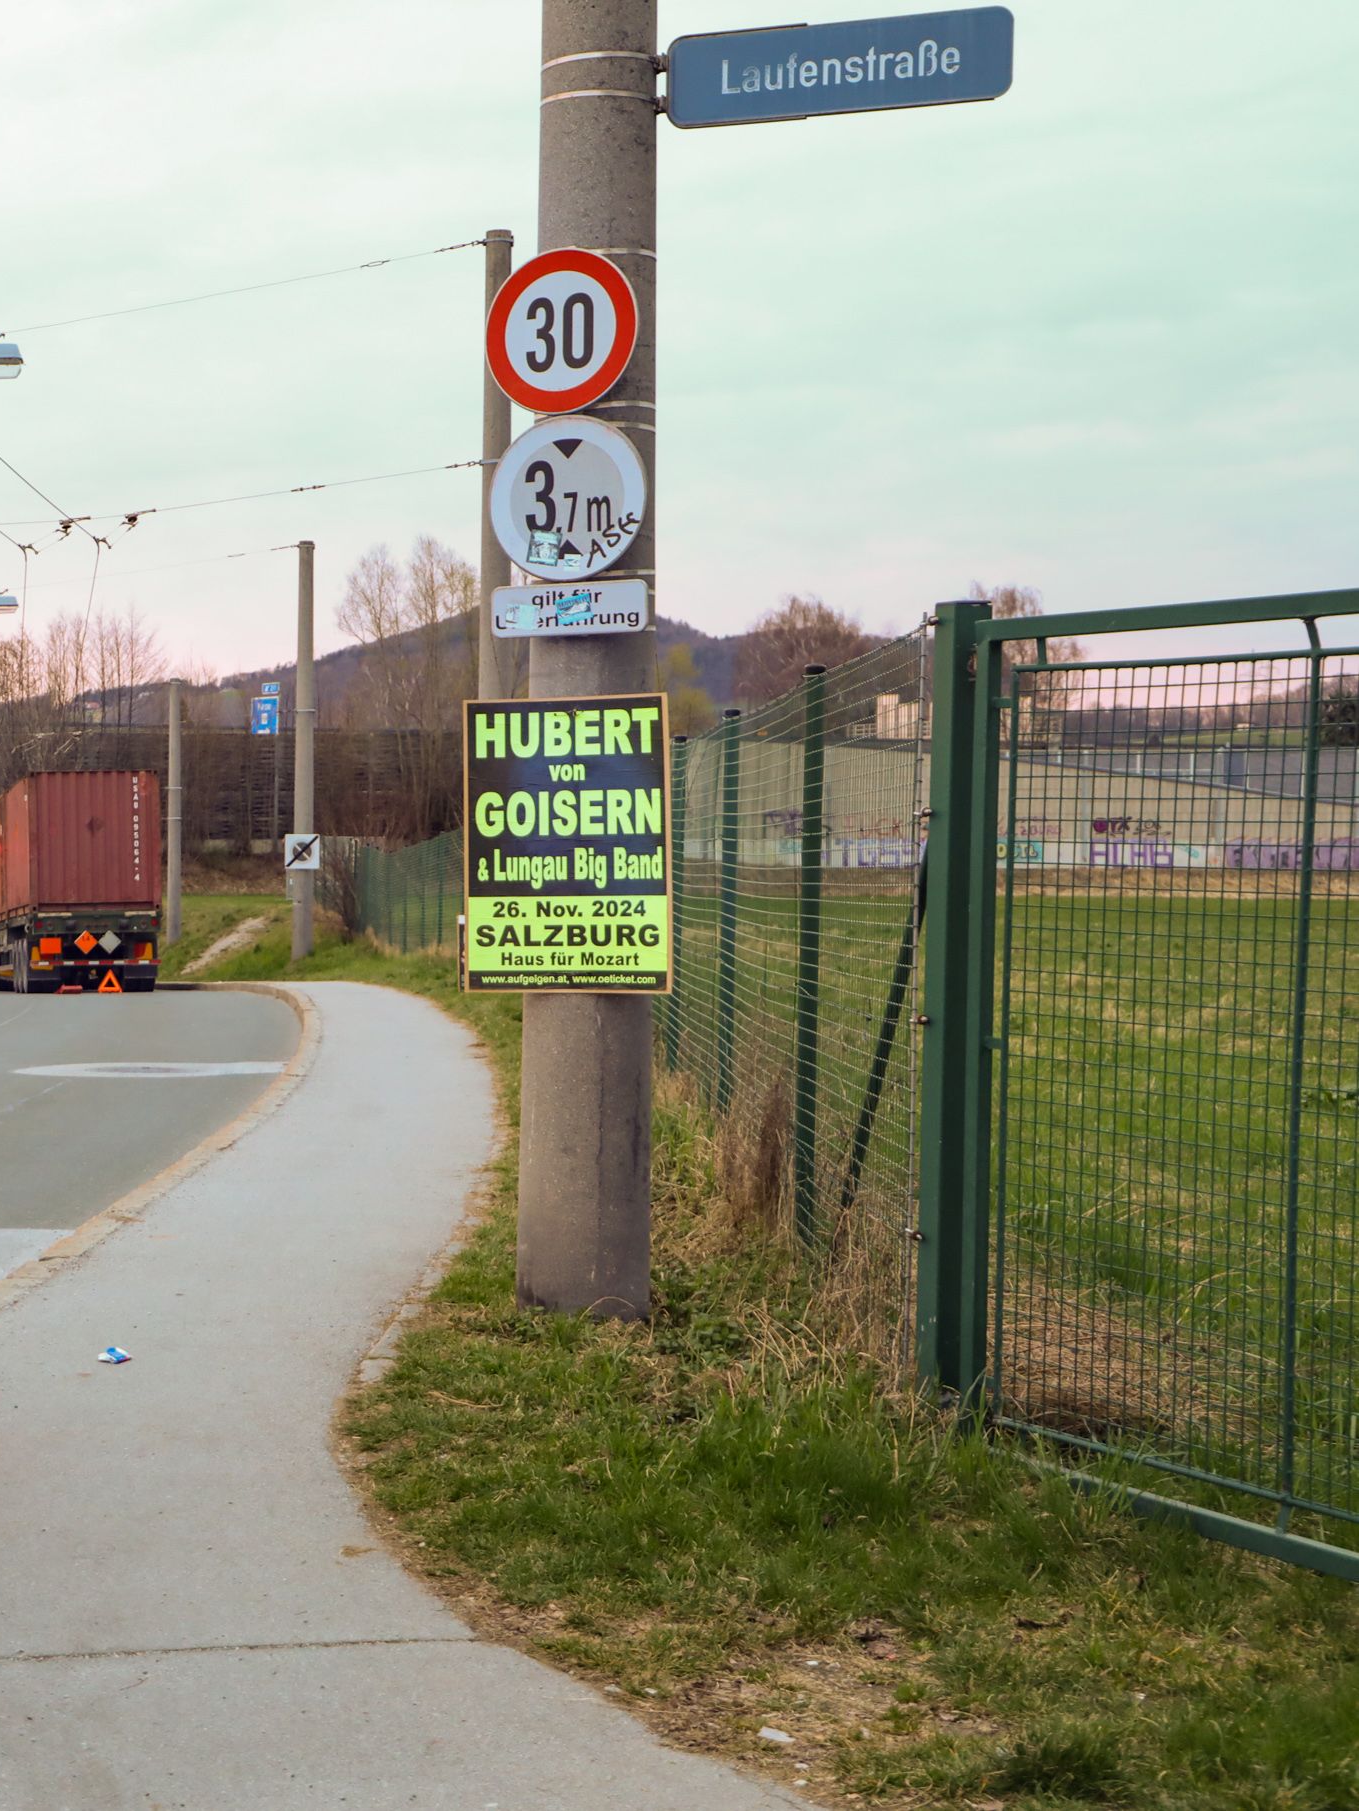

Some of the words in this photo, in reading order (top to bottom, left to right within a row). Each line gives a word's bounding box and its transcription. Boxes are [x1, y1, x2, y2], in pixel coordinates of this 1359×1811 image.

[721, 39, 960, 95] Laufenstraße
[526, 292, 594, 373] 30
[587, 495, 612, 532] m
[475, 707, 659, 759] HUBERT
[548, 763, 586, 783] von
[475, 788, 662, 838] GOISERN
[477, 857, 490, 882] &
[493, 849, 568, 890] Lungau
[573, 847, 608, 890] Big
[613, 846, 663, 881] Band
[493, 901, 527, 918] 26.
[536, 901, 583, 918] Nov.
[592, 900, 646, 917] 2024
[476, 924, 660, 948] SALZBURG
[501, 952, 544, 966] Haus
[550, 952, 573, 966] für
[581, 952, 639, 966] Mozart
[481, 974, 570, 985] www.aufgeigen.at,
[572, 973, 656, 985] www.oeticket.com
